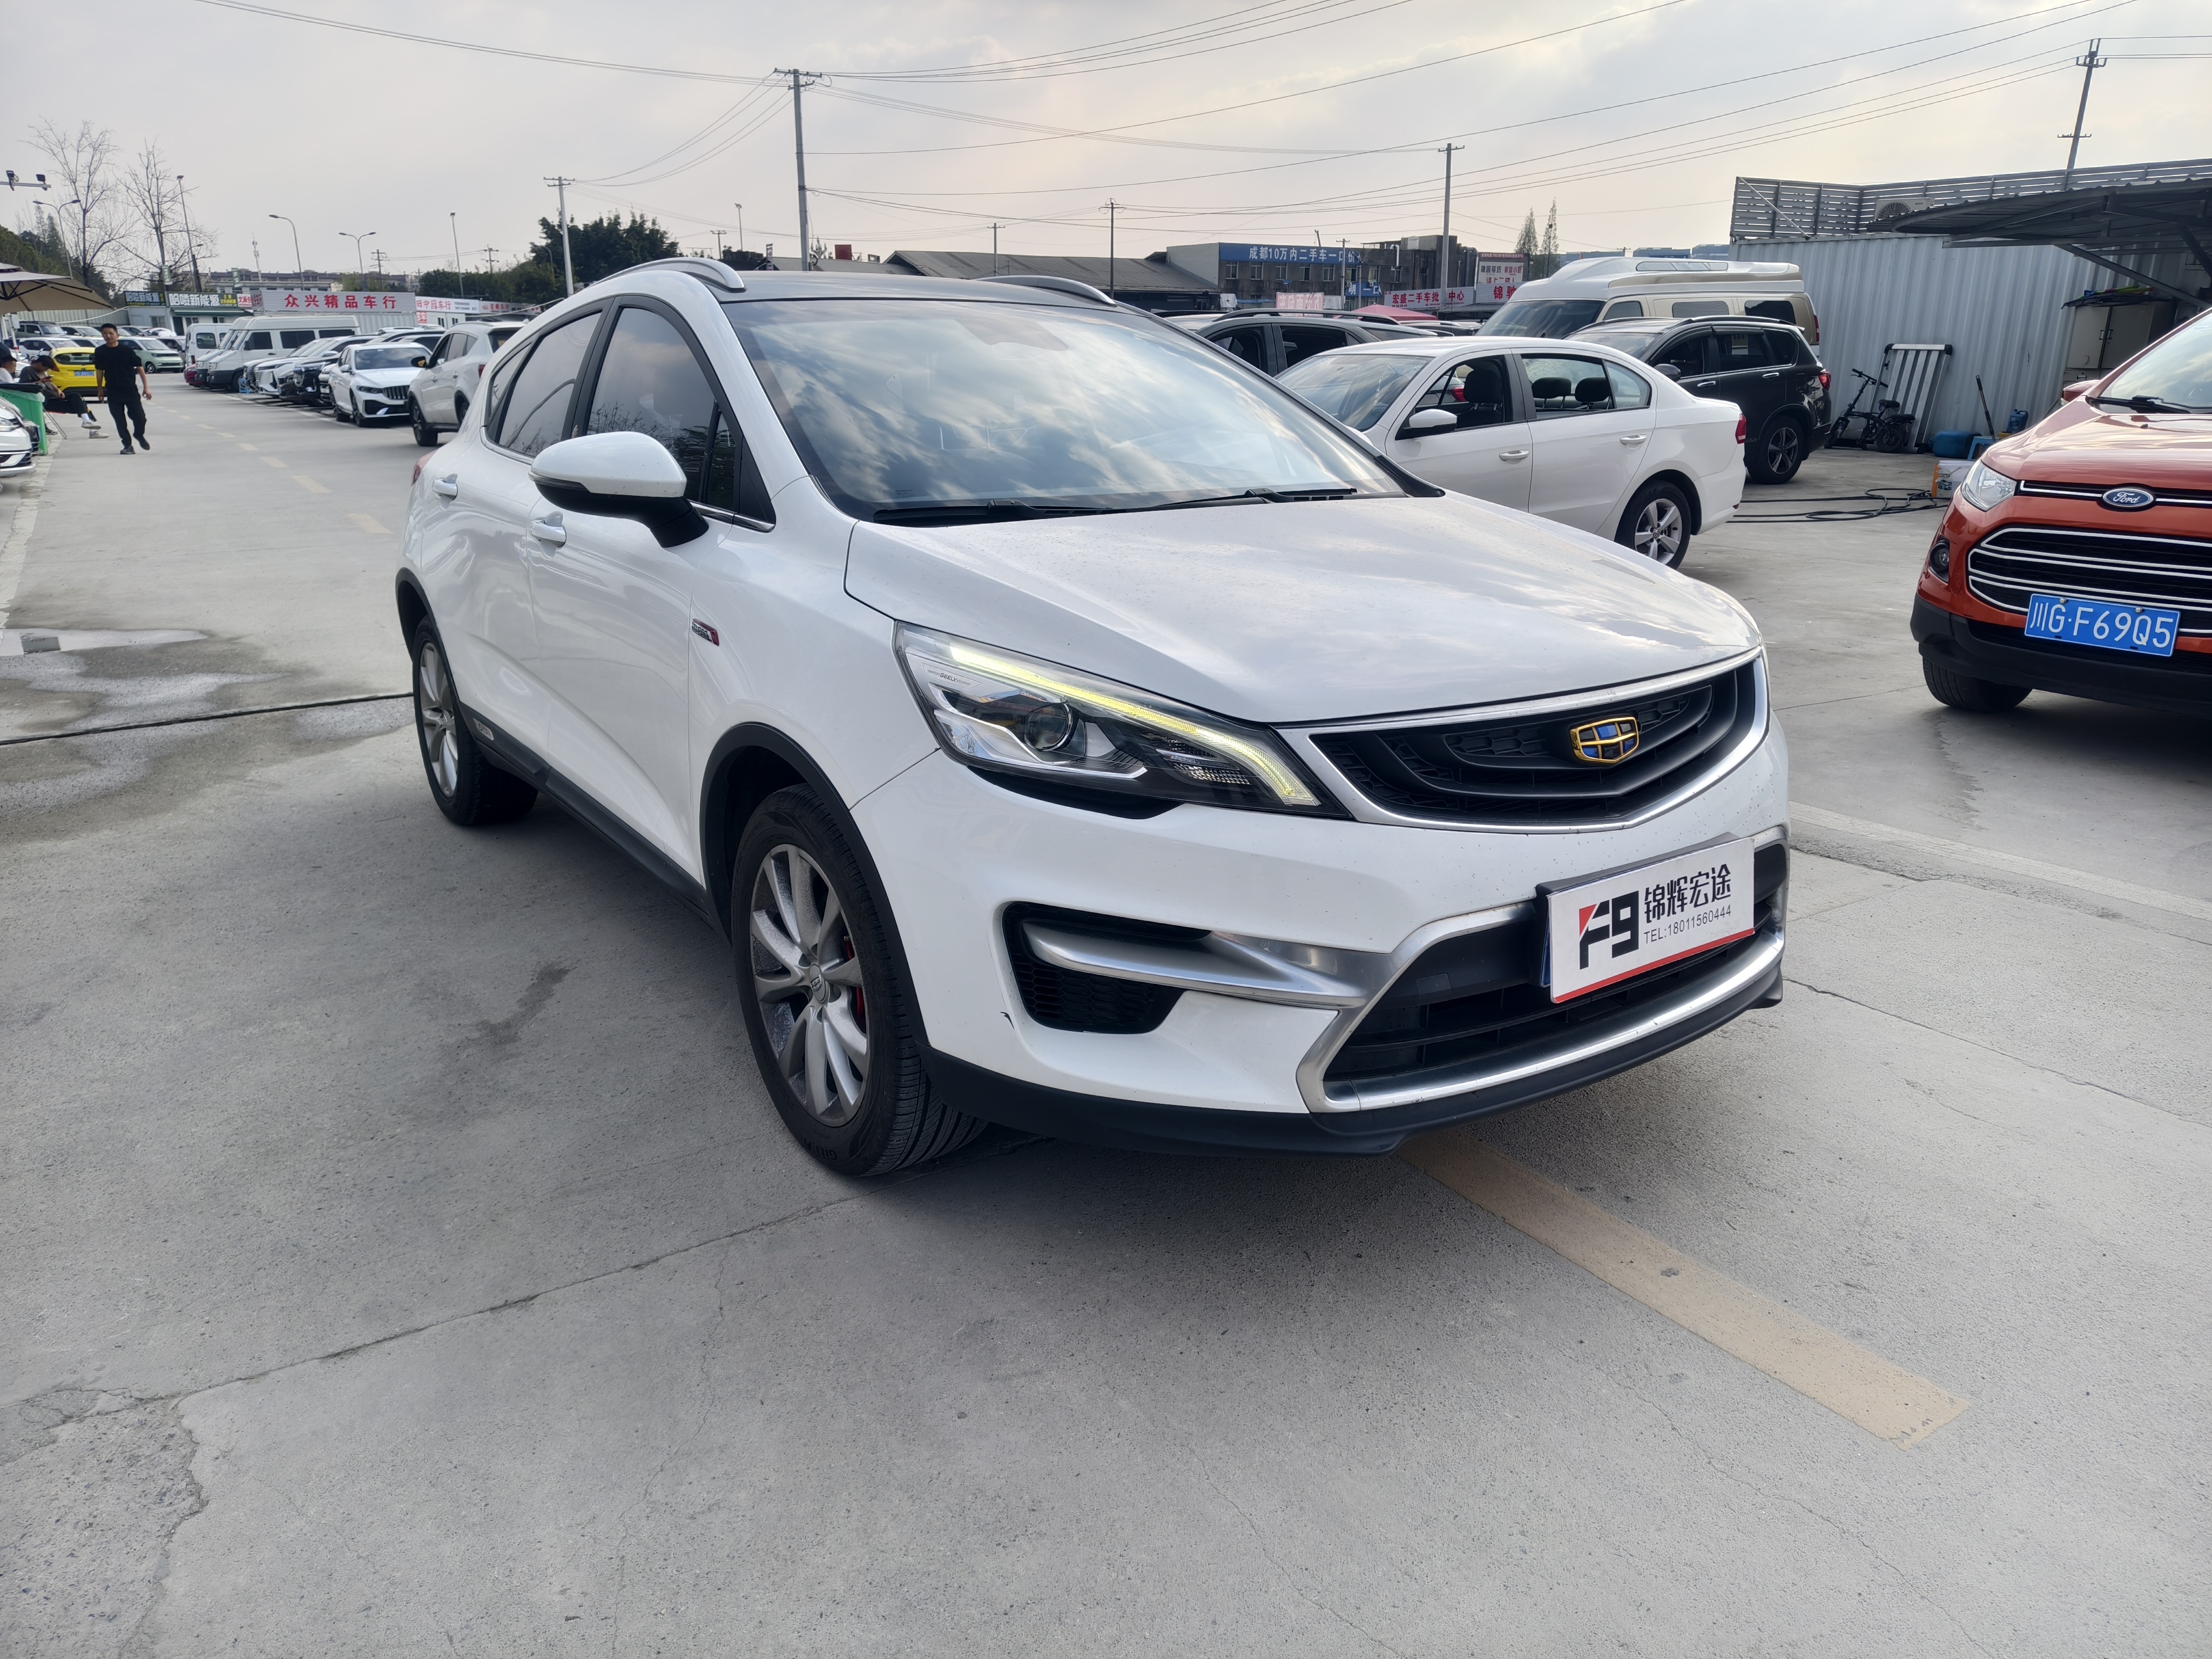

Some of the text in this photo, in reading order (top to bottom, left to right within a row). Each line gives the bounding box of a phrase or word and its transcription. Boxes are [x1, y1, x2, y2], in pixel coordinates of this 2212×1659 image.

[284, 294, 396, 309] 众兴精品车行
[1392, 290, 1465, 304] 宏盛二手车批中心
[2113, 491, 2139, 504] Ford
[940, 672, 958, 682] GEELY
[1644, 864, 1731, 924] 锦辉宏途
[1644, 904, 1731, 944] TEL:18011560444
